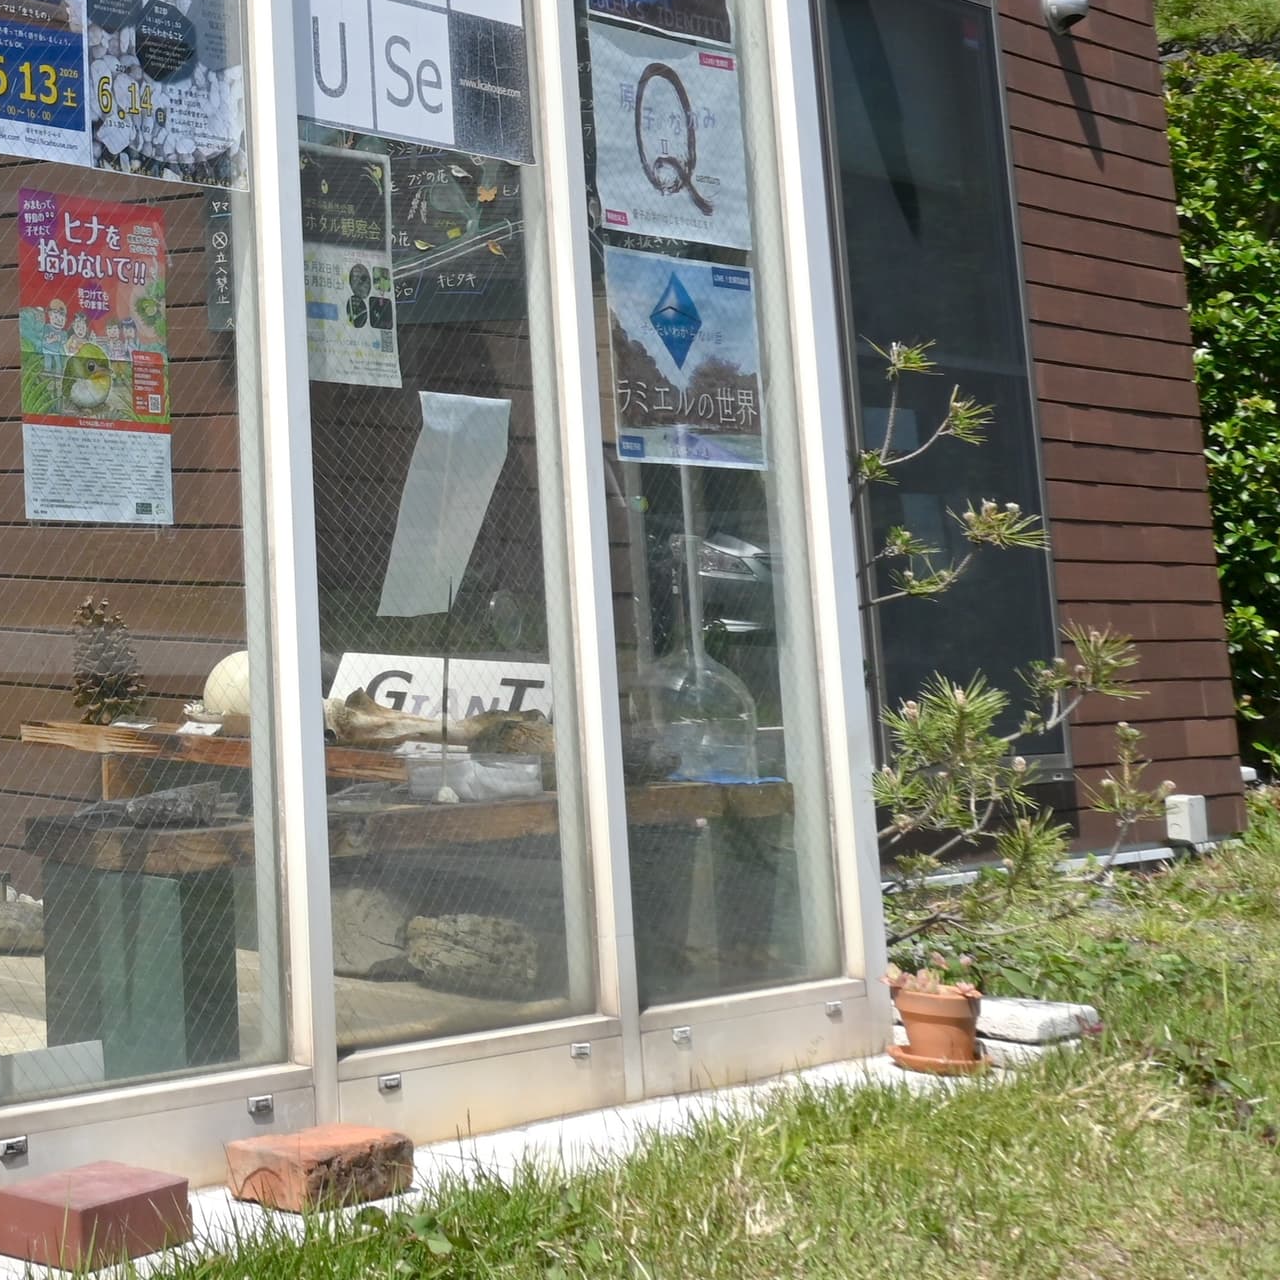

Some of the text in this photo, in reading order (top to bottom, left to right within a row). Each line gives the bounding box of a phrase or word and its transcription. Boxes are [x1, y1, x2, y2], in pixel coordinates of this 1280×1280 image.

[312, 15, 348, 99] U
[384, 34, 444, 114] Se
[63, 88, 77, 107] 土
[64, 212, 121, 250] ヒナを
[617, 379, 757, 425] ラミエルの世界
